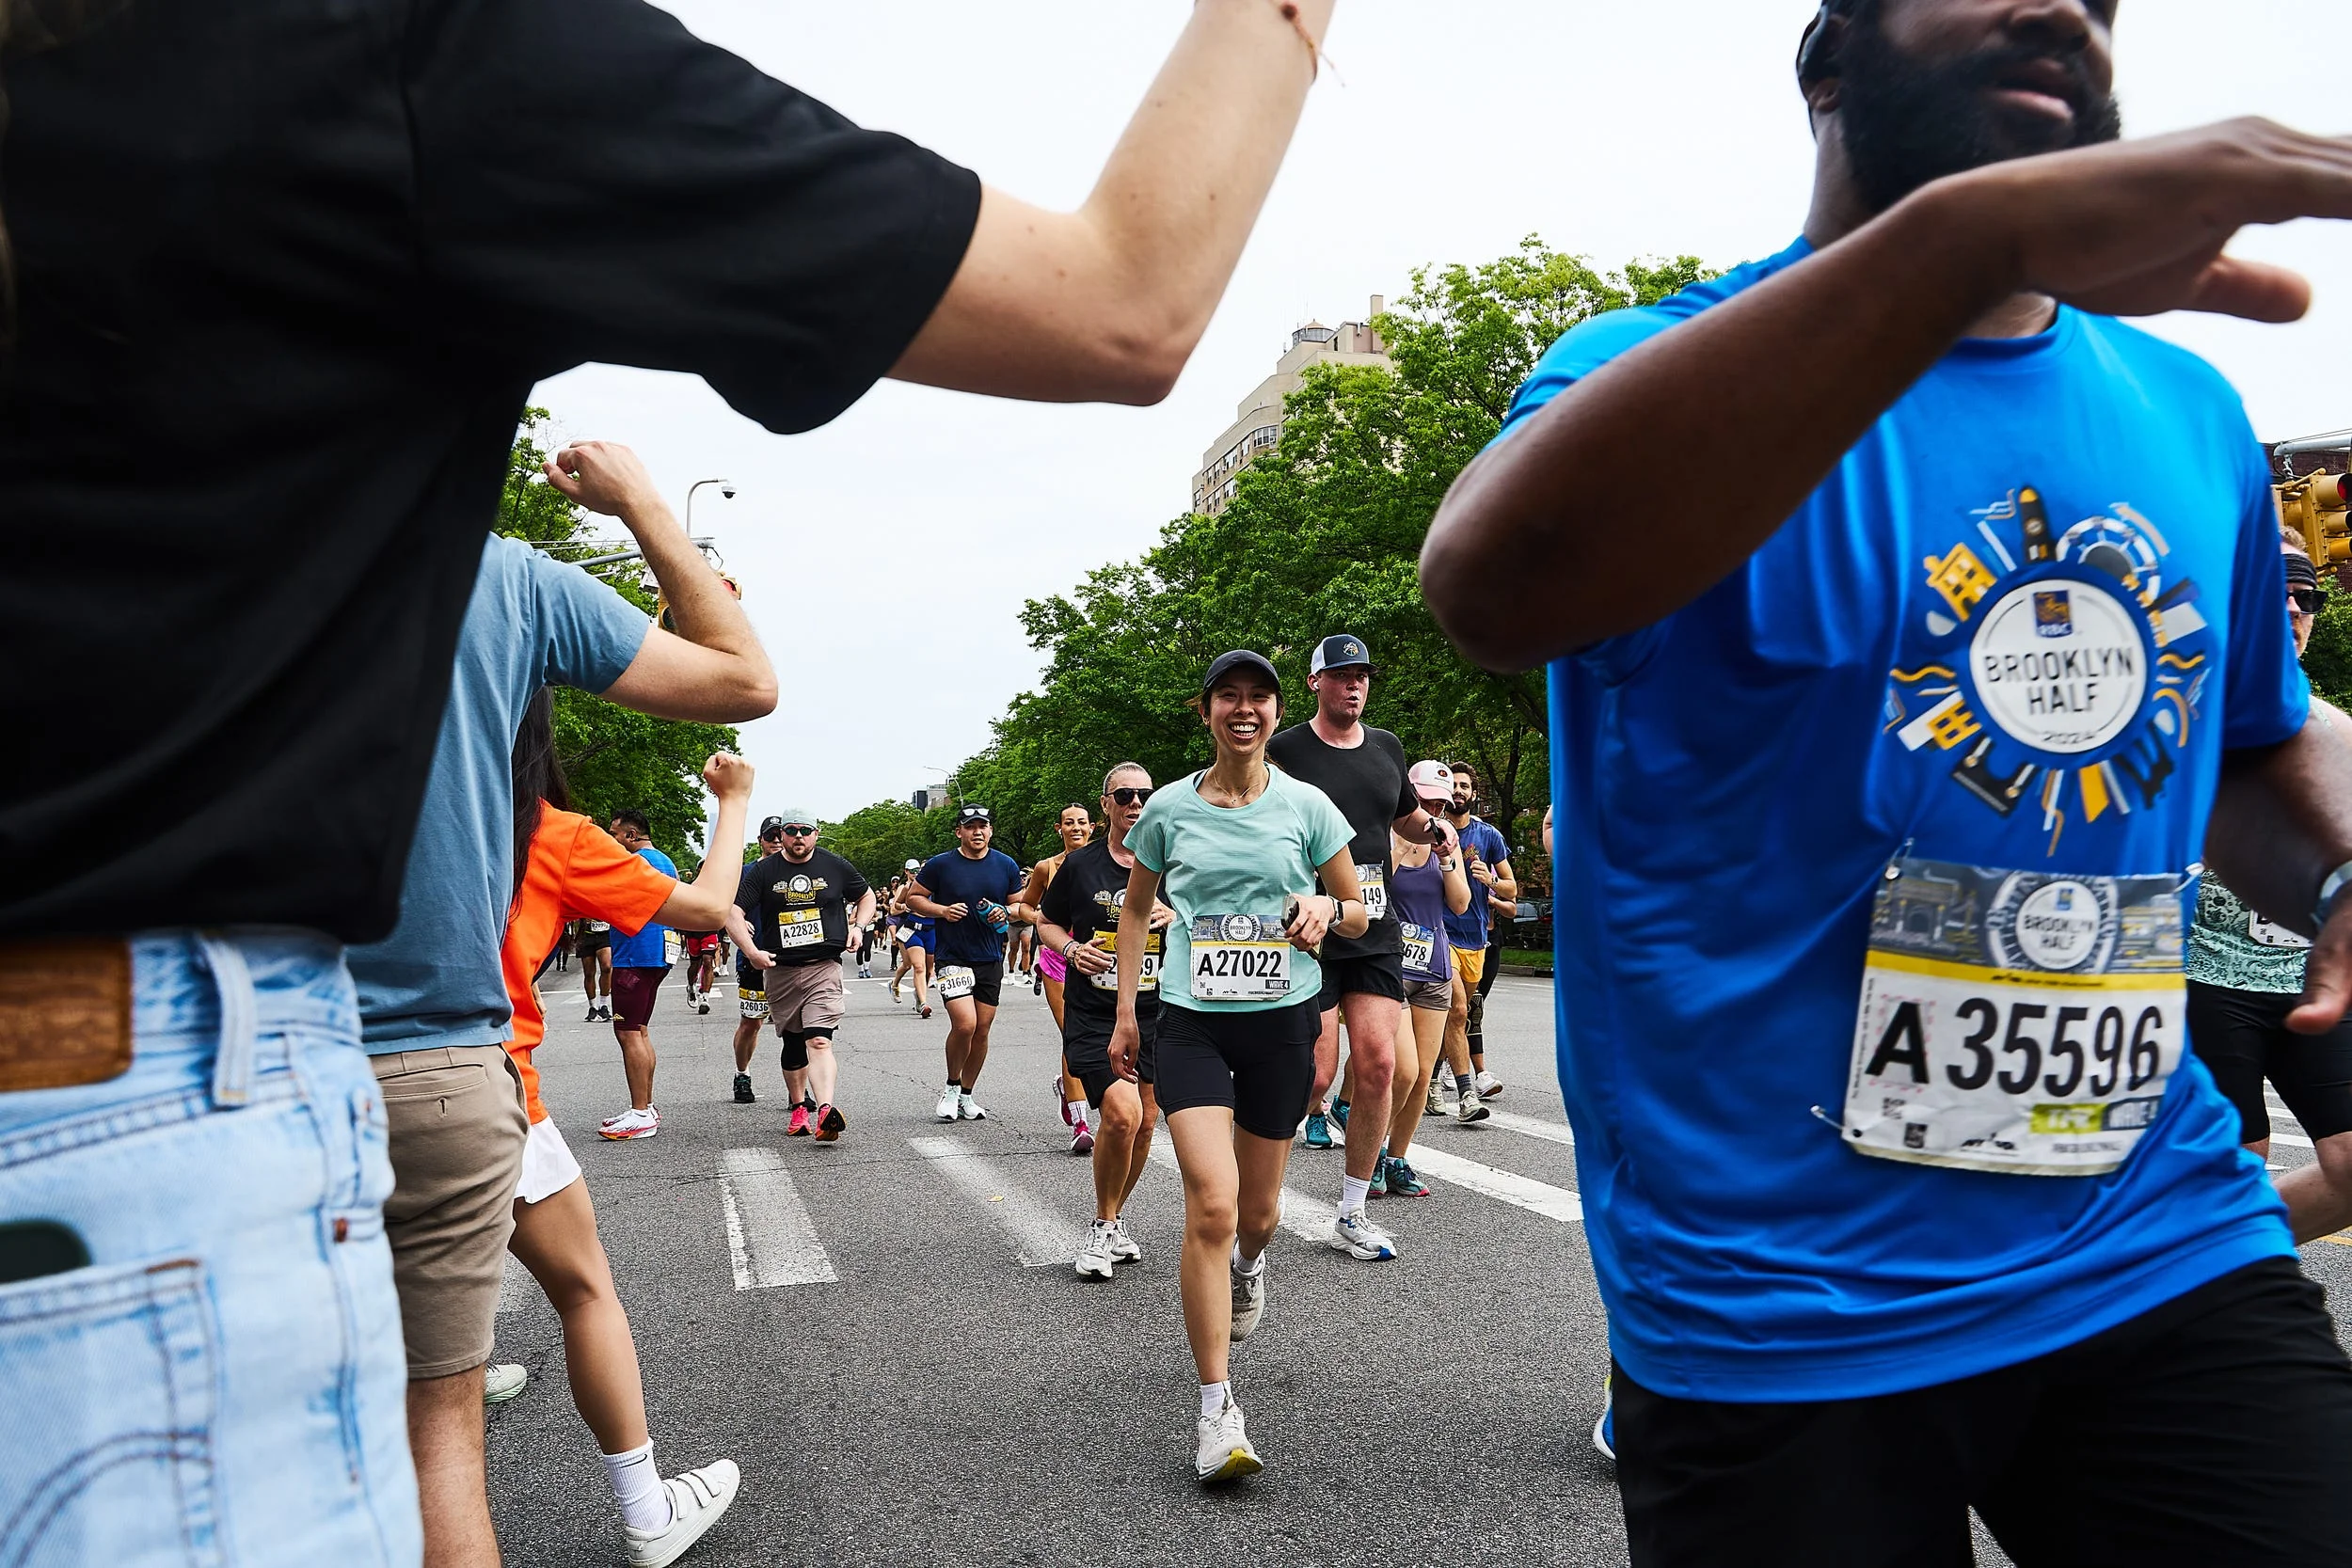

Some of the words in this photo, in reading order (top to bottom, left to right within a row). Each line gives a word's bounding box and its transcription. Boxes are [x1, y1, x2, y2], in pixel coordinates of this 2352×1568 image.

[1985, 647, 2134, 682] BROOKLYN
[2028, 683, 2097, 715] HALF
[1362, 887, 1381, 905] 149
[783, 922, 819, 939] A22828
[1403, 942, 1427, 960] 678
[1197, 949, 1282, 977] A27022
[1268, 980, 1283, 989] WAVE
